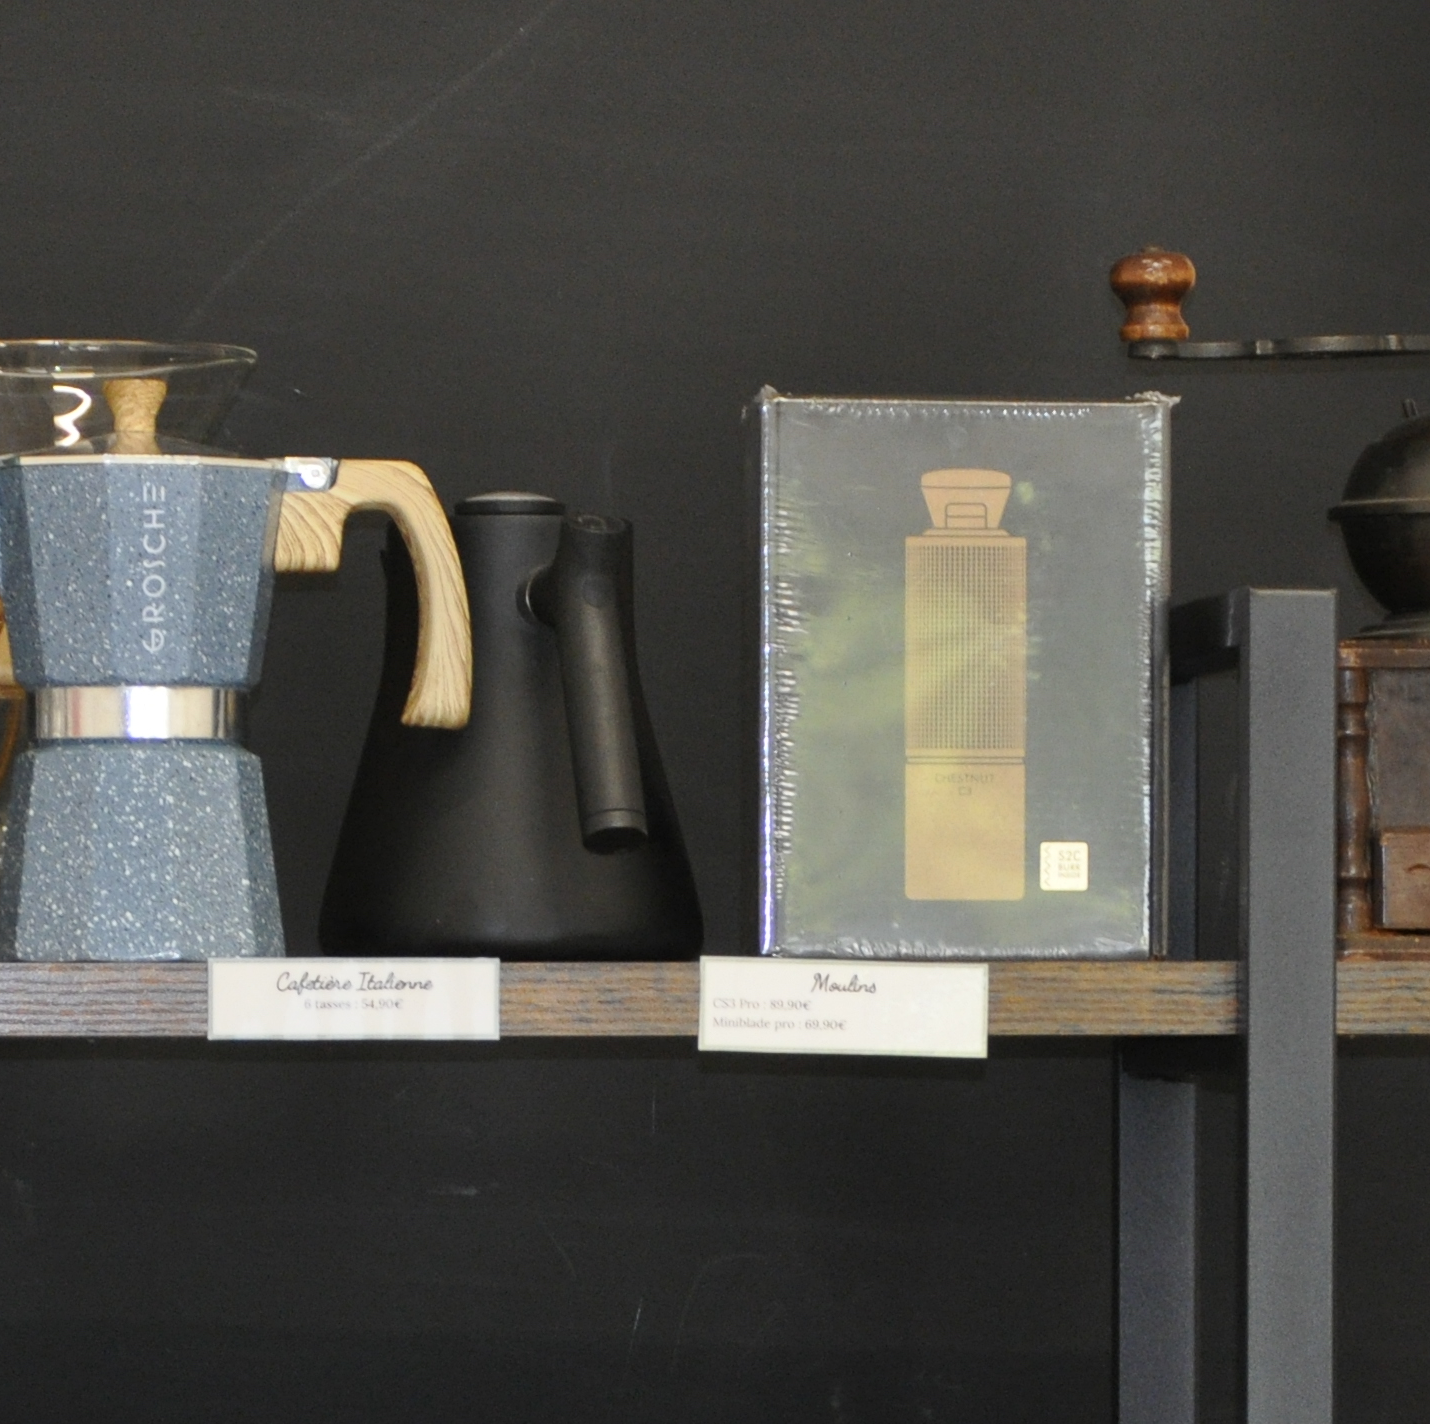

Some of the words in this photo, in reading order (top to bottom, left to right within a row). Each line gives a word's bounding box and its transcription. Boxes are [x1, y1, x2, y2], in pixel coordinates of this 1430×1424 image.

[142, 484, 166, 654] GROSCHE
[276, 971, 352, 996] Cafetière
[356, 971, 434, 992] Italienne
[810, 973, 877, 994] Moulins
[315, 1000, 351, 1010] tasses
[740, 998, 760, 1010] Pro
